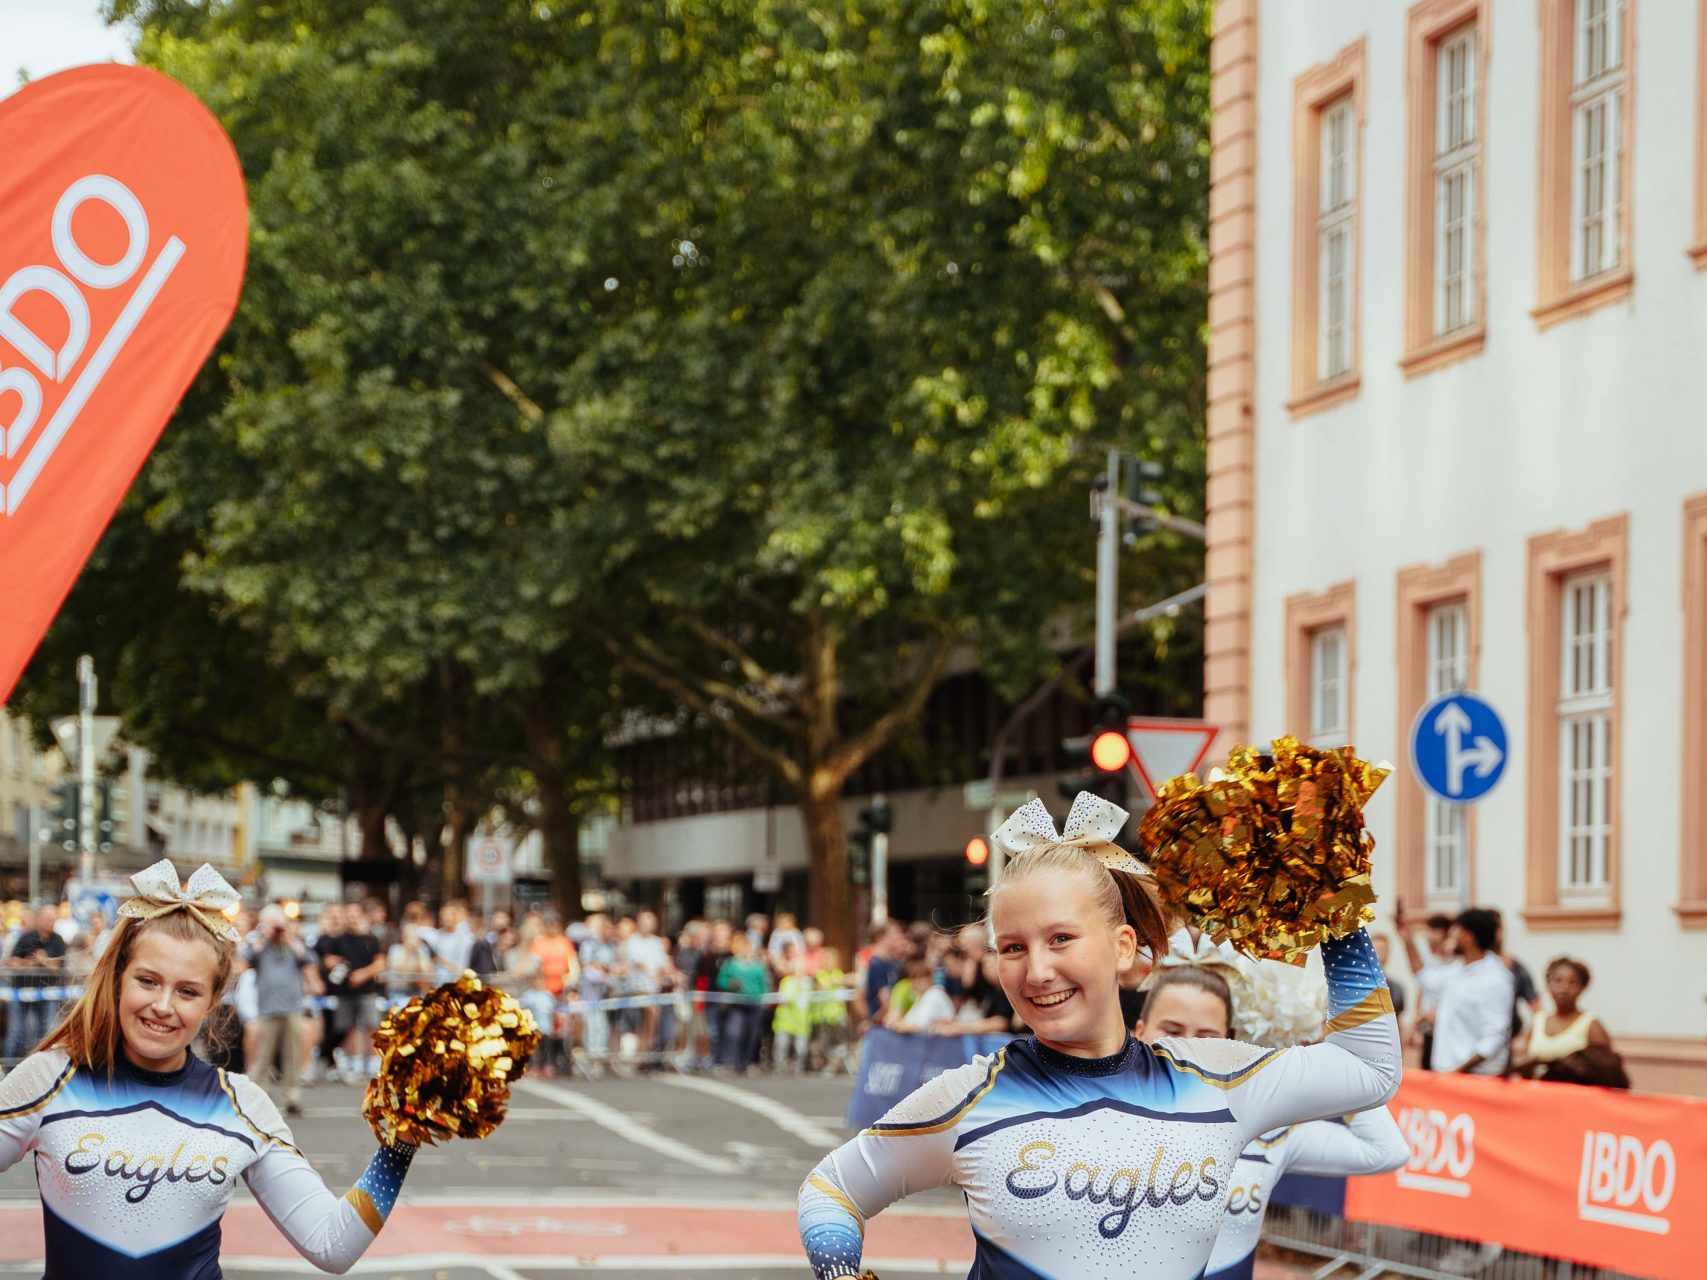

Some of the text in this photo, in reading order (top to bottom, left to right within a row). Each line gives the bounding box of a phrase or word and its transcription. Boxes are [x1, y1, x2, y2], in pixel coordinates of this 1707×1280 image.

[65, 1132, 229, 1203] Eagles
[1407, 1107, 1475, 1179] BDO
[1592, 1131, 1677, 1213] BDO
[1005, 1140, 1219, 1240] Eagles
